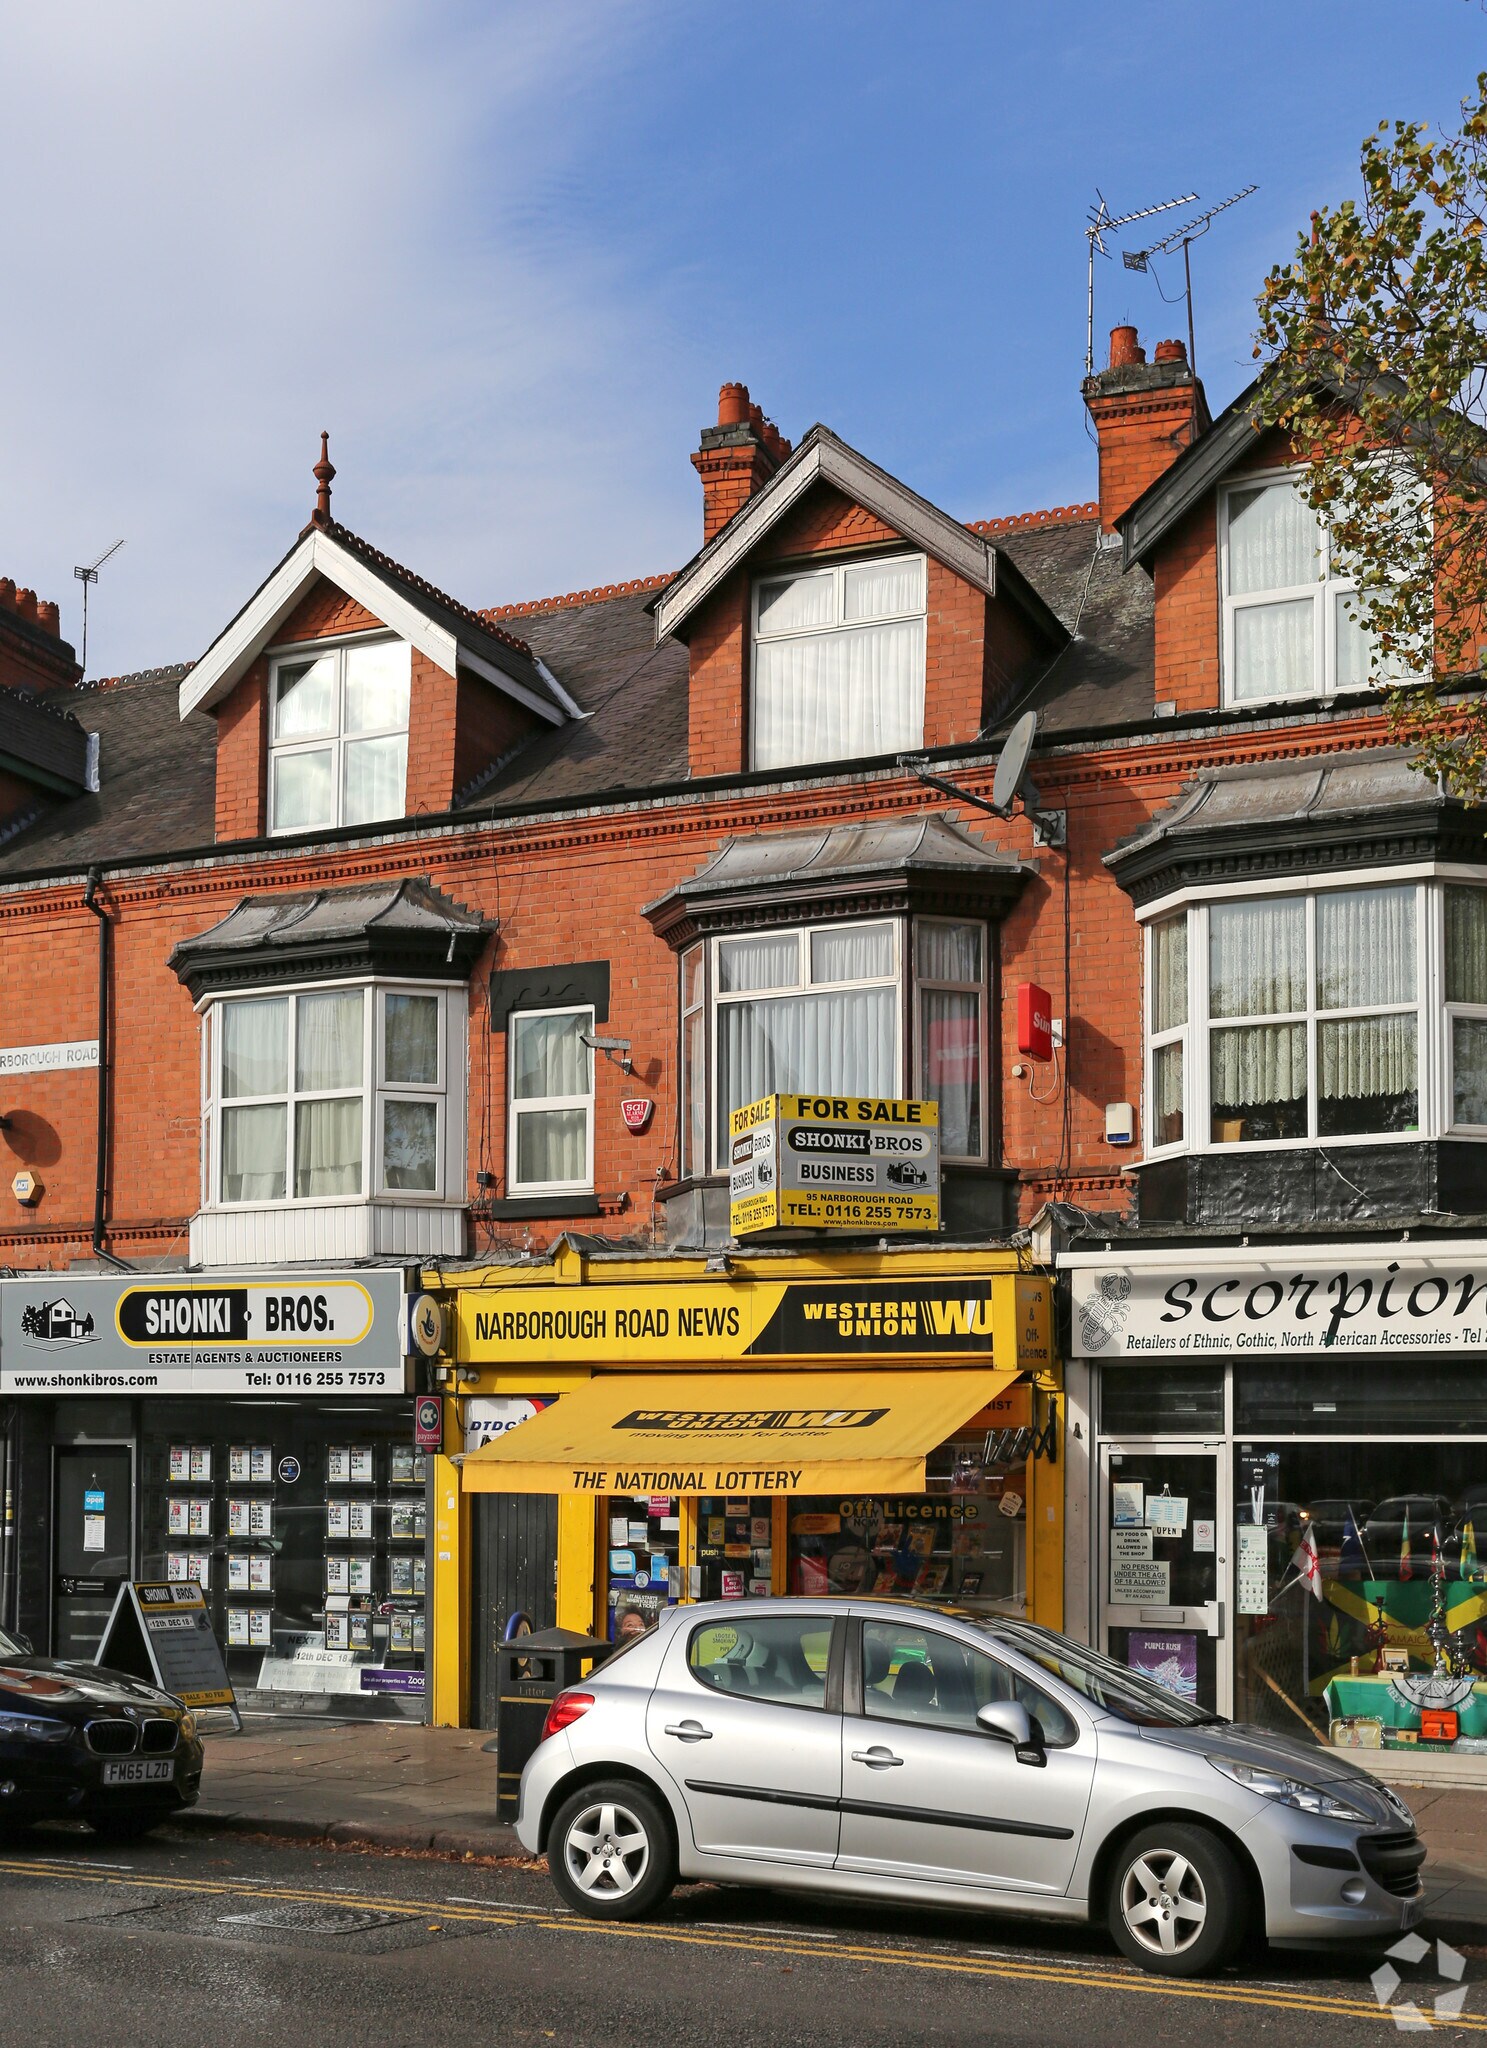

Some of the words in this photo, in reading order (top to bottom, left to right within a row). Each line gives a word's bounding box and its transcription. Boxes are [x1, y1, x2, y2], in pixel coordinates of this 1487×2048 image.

[67, 1047, 98, 1062] ROAD
[626, 1101, 644, 1112] sai
[798, 1098, 849, 1119] FOR
[858, 1101, 921, 1123] SALE
[734, 1110, 748, 1132] FOR
[750, 1100, 770, 1126] SALE
[754, 1134, 771, 1151] BROS
[795, 1132, 865, 1149] SHONKI
[875, 1136, 922, 1151] BROS
[733, 1168, 753, 1191] BUSINESS
[801, 1164, 874, 1182] BUSINESS
[16, 1181, 29, 1190] ADT
[806, 1193, 818, 1201] 95
[820, 1194, 887, 1204] NARBOROUGH
[889, 1196, 913, 1204] ROAD
[788, 1204, 821, 1216] TEL:
[826, 1205, 863, 1218] 0116
[866, 1206, 892, 1219] 255
[896, 1207, 931, 1220] 7573
[823, 1219, 898, 1227] www.shonkibros.com
[145, 1297, 231, 1334] SHONKI
[265, 1295, 334, 1332] BROS.
[803, 1301, 916, 1319] WESTERN
[1029, 1307, 1035, 1321] &
[475, 1309, 606, 1340] NARBOROUGH
[615, 1309, 668, 1338] ROAD
[679, 1306, 740, 1337] NEWS
[839, 1319, 916, 1336] UNION
[1126, 1333, 1176, 1350] Retailers
[1179, 1332, 1192, 1348] of
[1193, 1332, 1233, 1350] Ethnic,
[1236, 1331, 1277, 1349] Gothic,
[1281, 1331, 1314, 1347] North
[1380, 1329, 1451, 1345] Accessories
[1462, 1328, 1481, 1343] Tel
[148, 1352, 191, 1364] ESTATE
[195, 1352, 241, 1363] AGENTS
[245, 1352, 253, 1363] &
[257, 1351, 343, 1363] AUCTIONEERS
[1018, 1345, 1047, 1359] Licence
[14, 1373, 158, 1386] www.shonkibros.com
[246, 1372, 272, 1386] Tel:
[276, 1372, 312, 1385] 0116
[316, 1372, 343, 1385] 255
[348, 1371, 385, 1385] 7573
[470, 1421, 517, 1431] DTDC
[636, 1412, 774, 1422] WESTERN
[785, 1411, 873, 1427] WU
[667, 1420, 766, 1429] UNION
[417, 1434, 440, 1442] payzone
[629, 1431, 690, 1439] moving
[780, 1430, 832, 1438] better
[573, 1471, 607, 1490] THE
[614, 1472, 707, 1490] NATIONAL
[715, 1470, 803, 1490] LOTTERY
[839, 1501, 874, 1518] Off
[883, 1501, 978, 1519] Licence
[1157, 1527, 1177, 1535] OPEN
[701, 1549, 719, 1557] push
[151, 1620, 166, 1628] 12th
[182, 1618, 190, 1626] 18
[287, 1636, 317, 1645] NEXT
[1144, 1642, 1165, 1650] PURPLE
[296, 1651, 313, 1660] 12th
[316, 1654, 333, 1662] DEC
[519, 1686, 546, 1696] Litter
[1386, 1685, 1407, 1708] KEEPS
[109, 1763, 143, 1780] FM65
[146, 1762, 169, 1779] LZD
